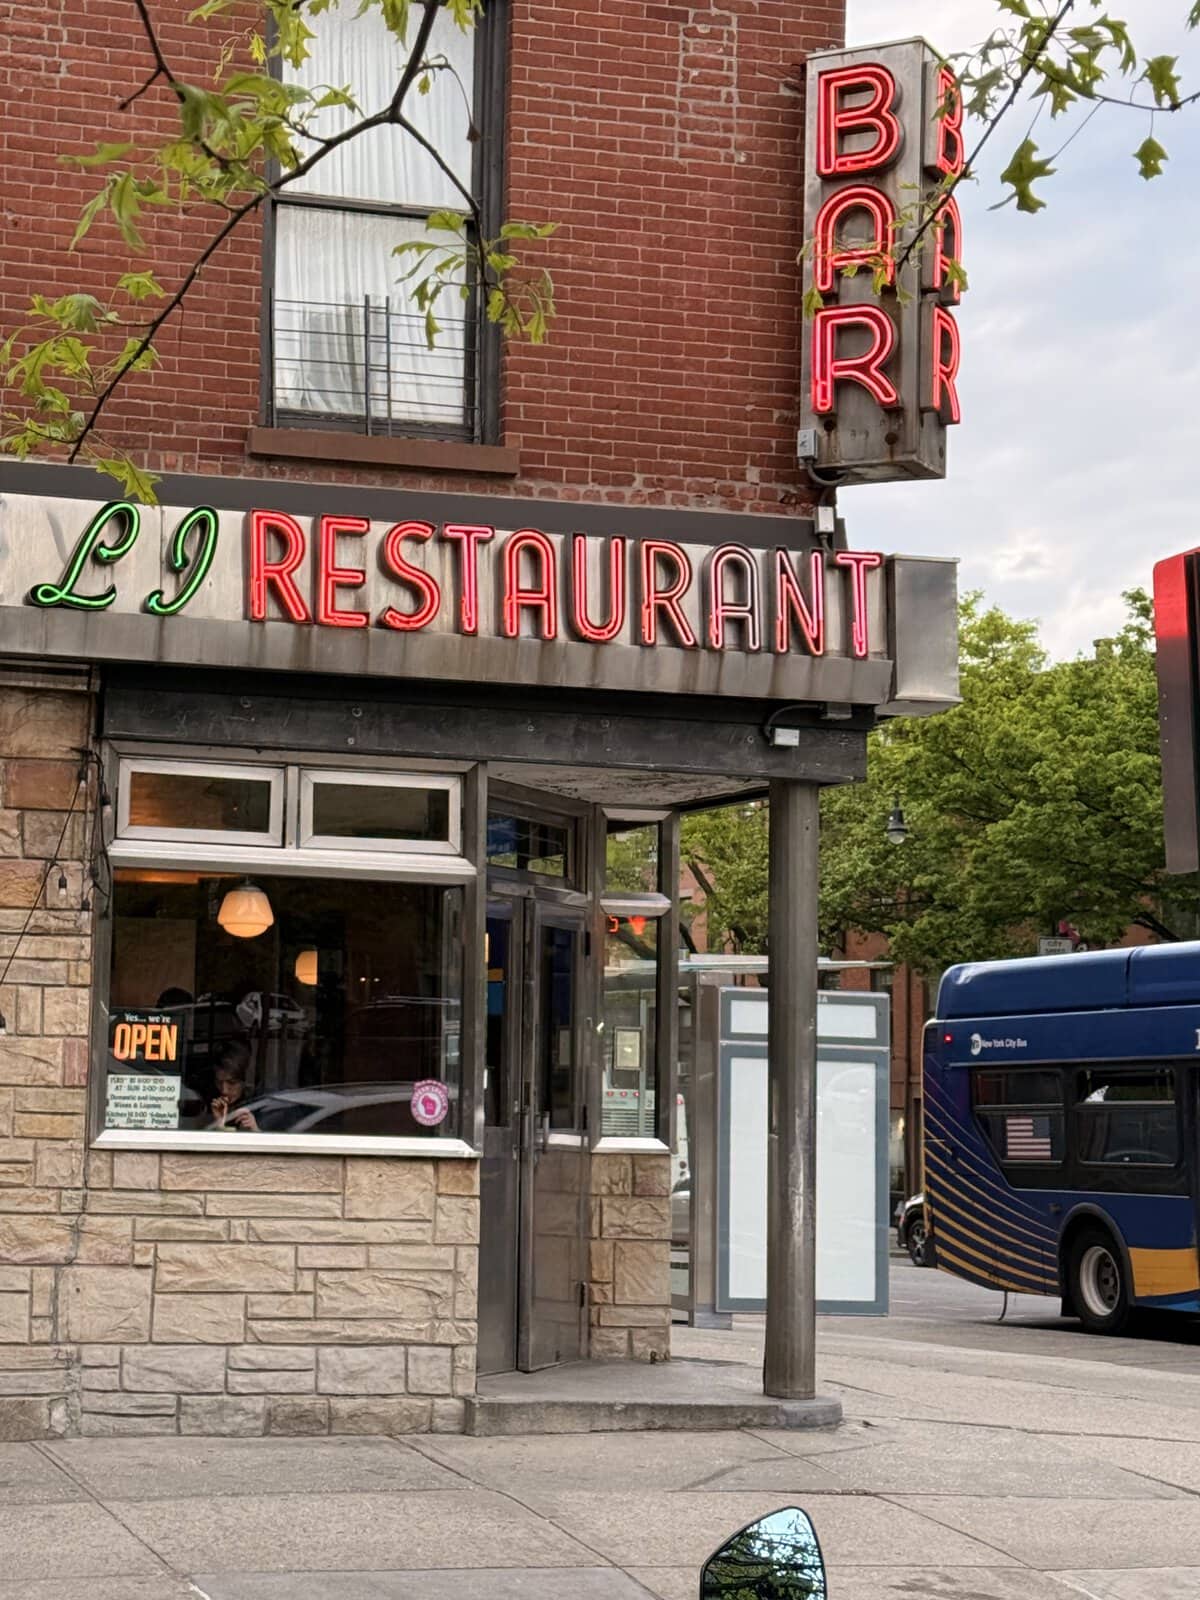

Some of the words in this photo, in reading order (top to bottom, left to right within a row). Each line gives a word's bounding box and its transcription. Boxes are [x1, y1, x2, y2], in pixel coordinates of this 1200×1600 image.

[811, 61, 900, 416] BAR
[932, 64, 963, 424] BAR
[247, 507, 884, 660] RESTAURANT
[113, 1023, 178, 1060] OPEN
[981, 1039, 992, 1048] New
[992, 1039, 1005, 1048] York
[1005, 1038, 1016, 1049] City
[1017, 1038, 1027, 1047] Bus
